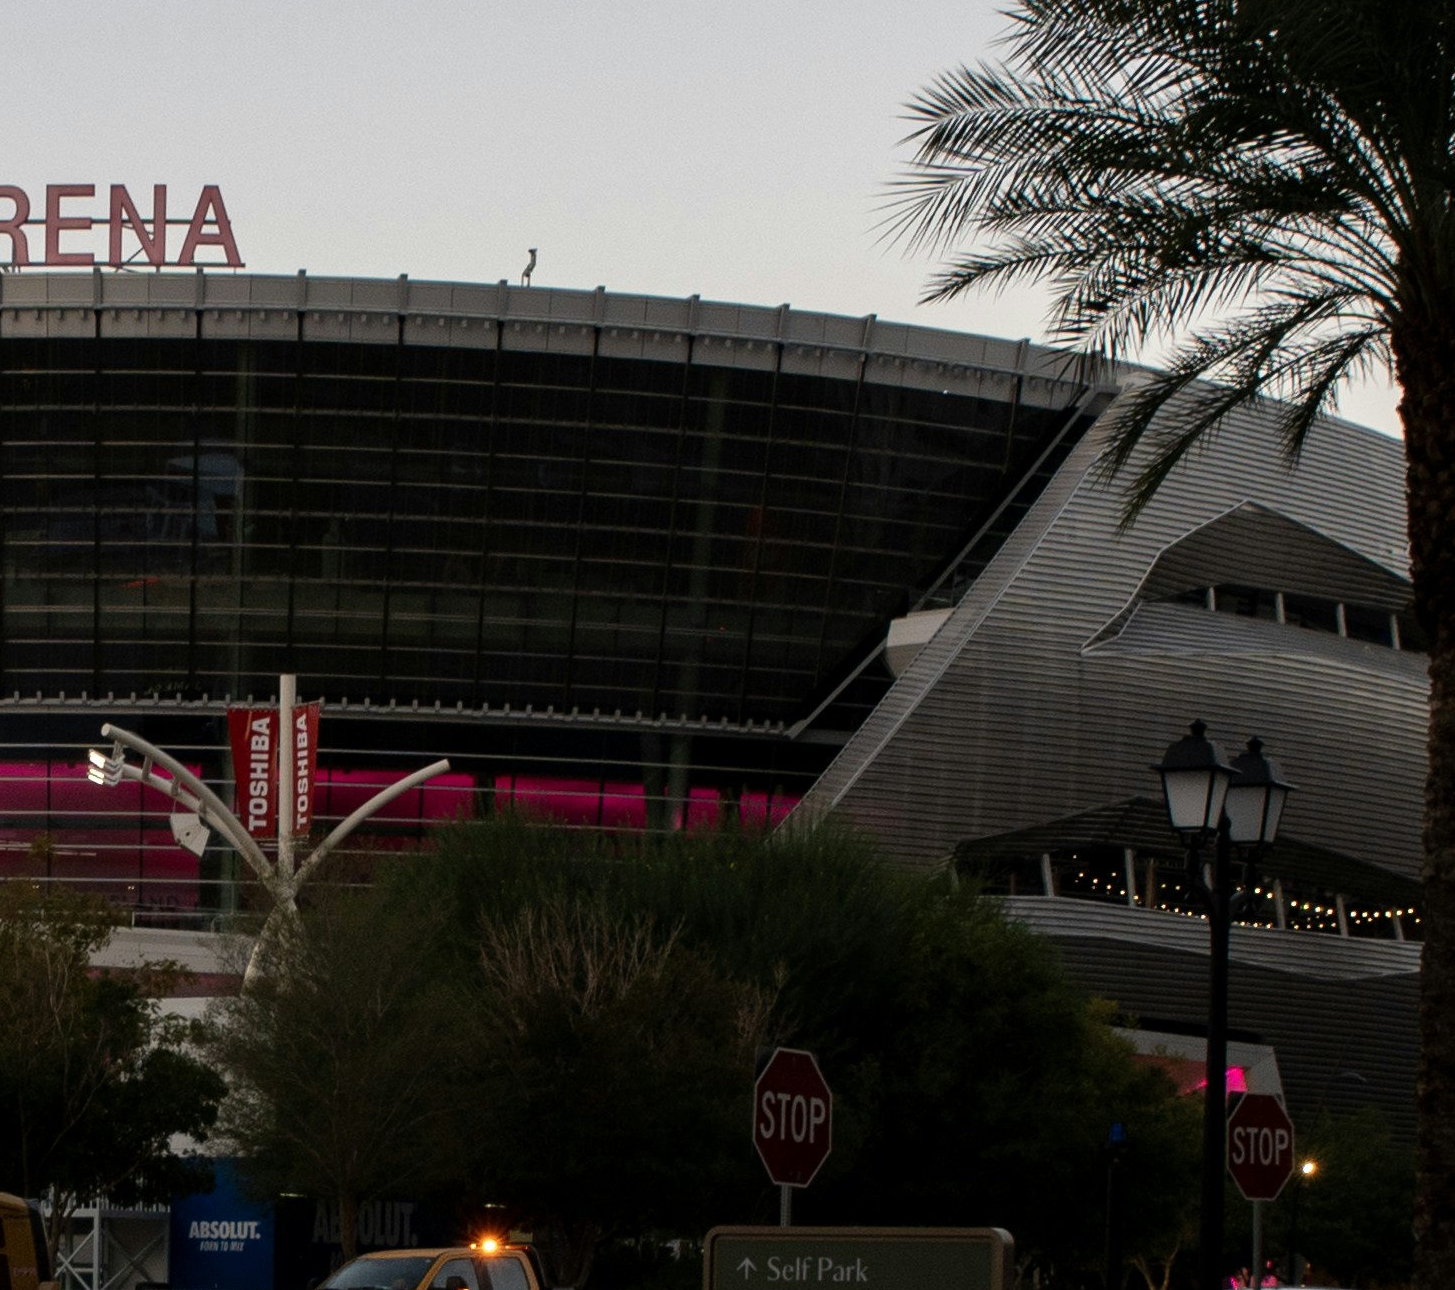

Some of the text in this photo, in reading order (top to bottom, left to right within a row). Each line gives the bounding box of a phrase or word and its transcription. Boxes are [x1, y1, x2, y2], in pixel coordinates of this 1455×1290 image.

[248, 717, 271, 831] TOSHIBA
[296, 713, 309, 830] TOSHIBA
[759, 1090, 826, 1144] STOP
[1232, 1126, 1289, 1166] STOP
[311, 1200, 419, 1247] ABOLUT.
[767, 1256, 868, 1282] Self Park
